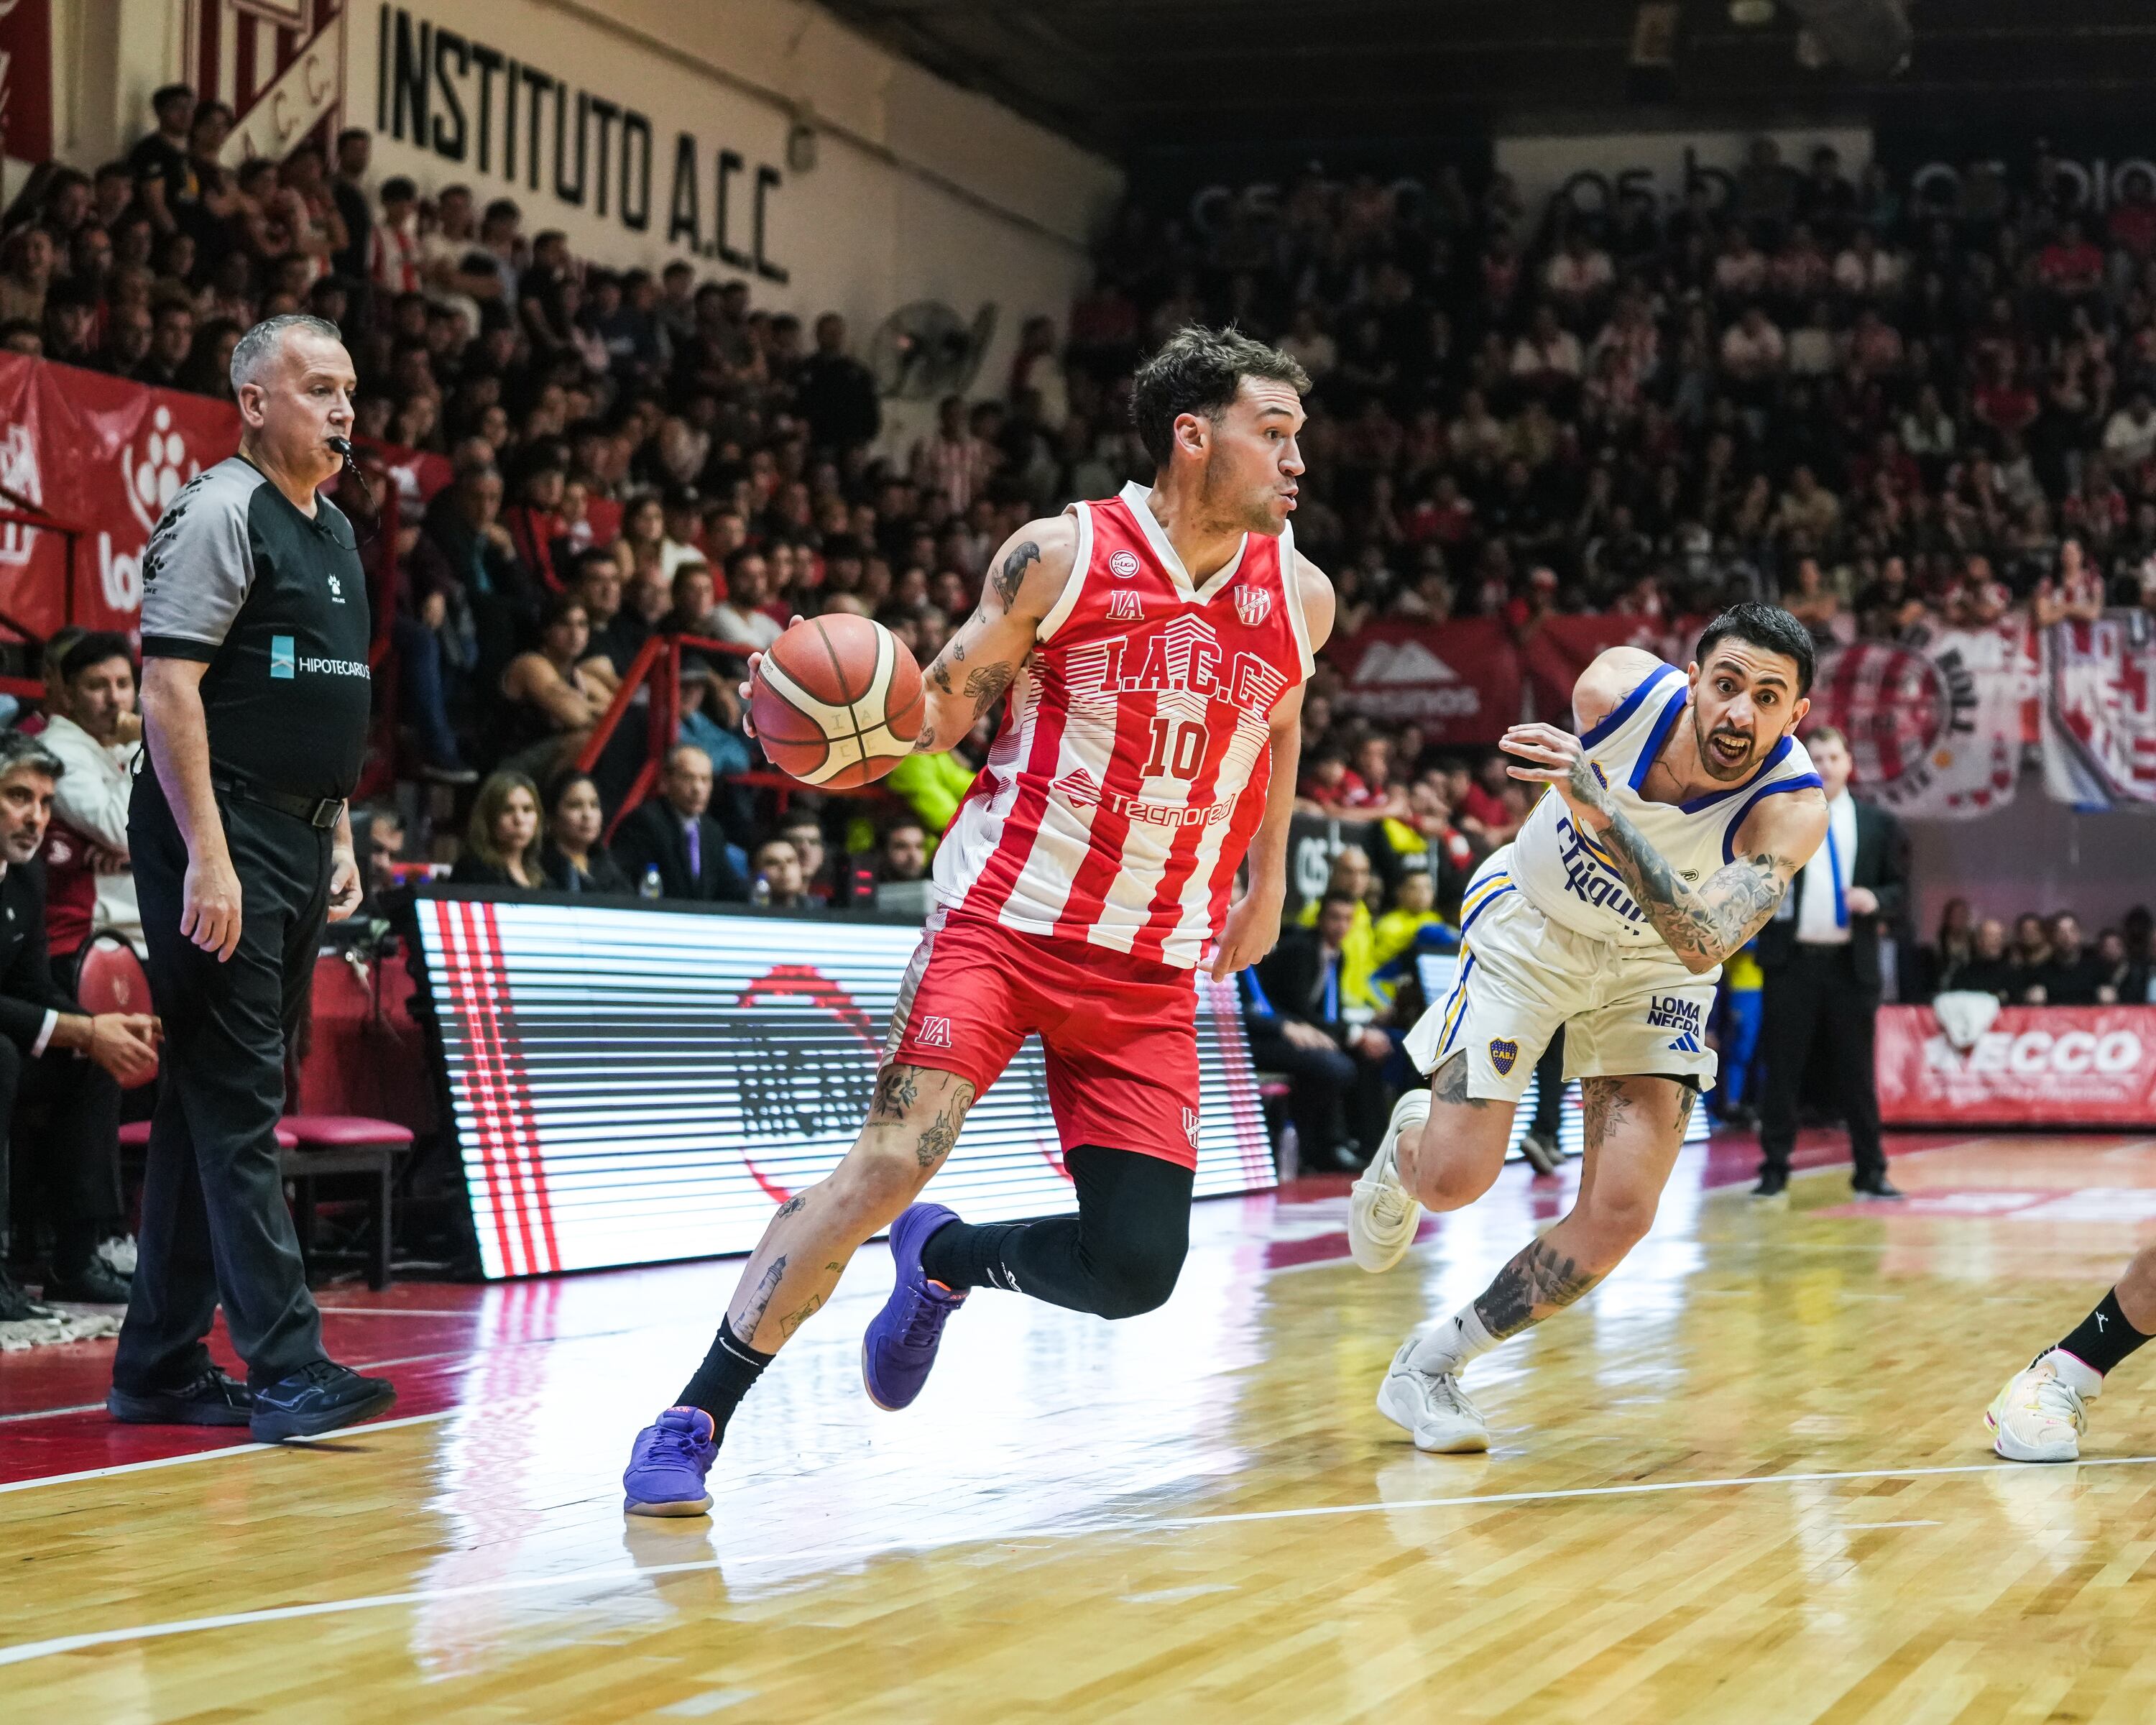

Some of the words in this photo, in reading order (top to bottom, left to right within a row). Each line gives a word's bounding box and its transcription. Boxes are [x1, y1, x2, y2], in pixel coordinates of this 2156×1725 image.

[377, 2, 653, 232] INSTITUTO
[1105, 590, 1145, 620] IA
[299, 657, 365, 678] HIPOTECARIO
[1139, 716, 1210, 783] 10
[1109, 791, 1236, 827] Tecnored
[1651, 995, 1701, 1022] LOMA
[914, 1016, 952, 1048] IA
[1493, 1049, 1515, 1060] CABJ
